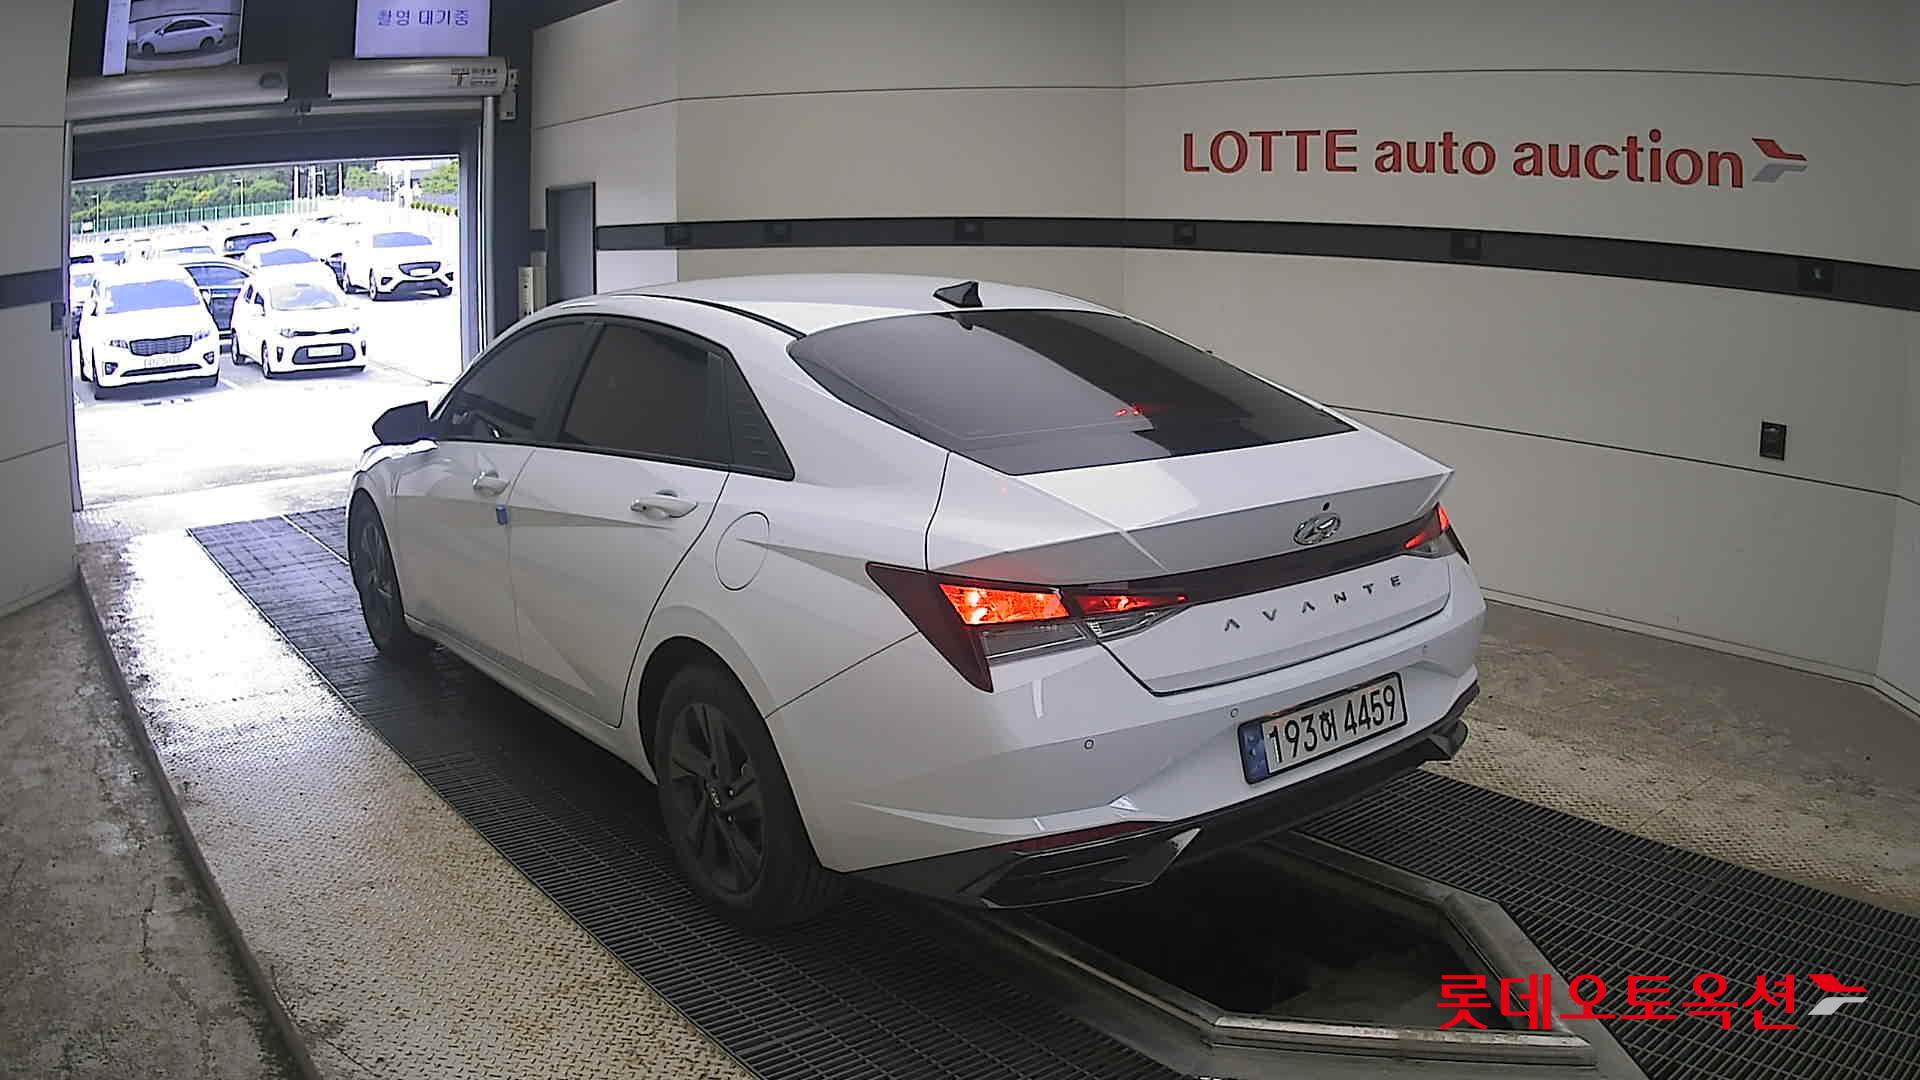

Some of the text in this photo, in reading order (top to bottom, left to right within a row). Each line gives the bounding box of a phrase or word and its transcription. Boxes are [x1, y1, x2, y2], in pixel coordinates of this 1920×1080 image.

[418, 9, 469, 26] 대기중
[1183, 129, 1744, 188] LOTTE auto auction
[1224, 575, 1401, 632] AVANTE
[1268, 685, 1396, 763] 193허 4459
